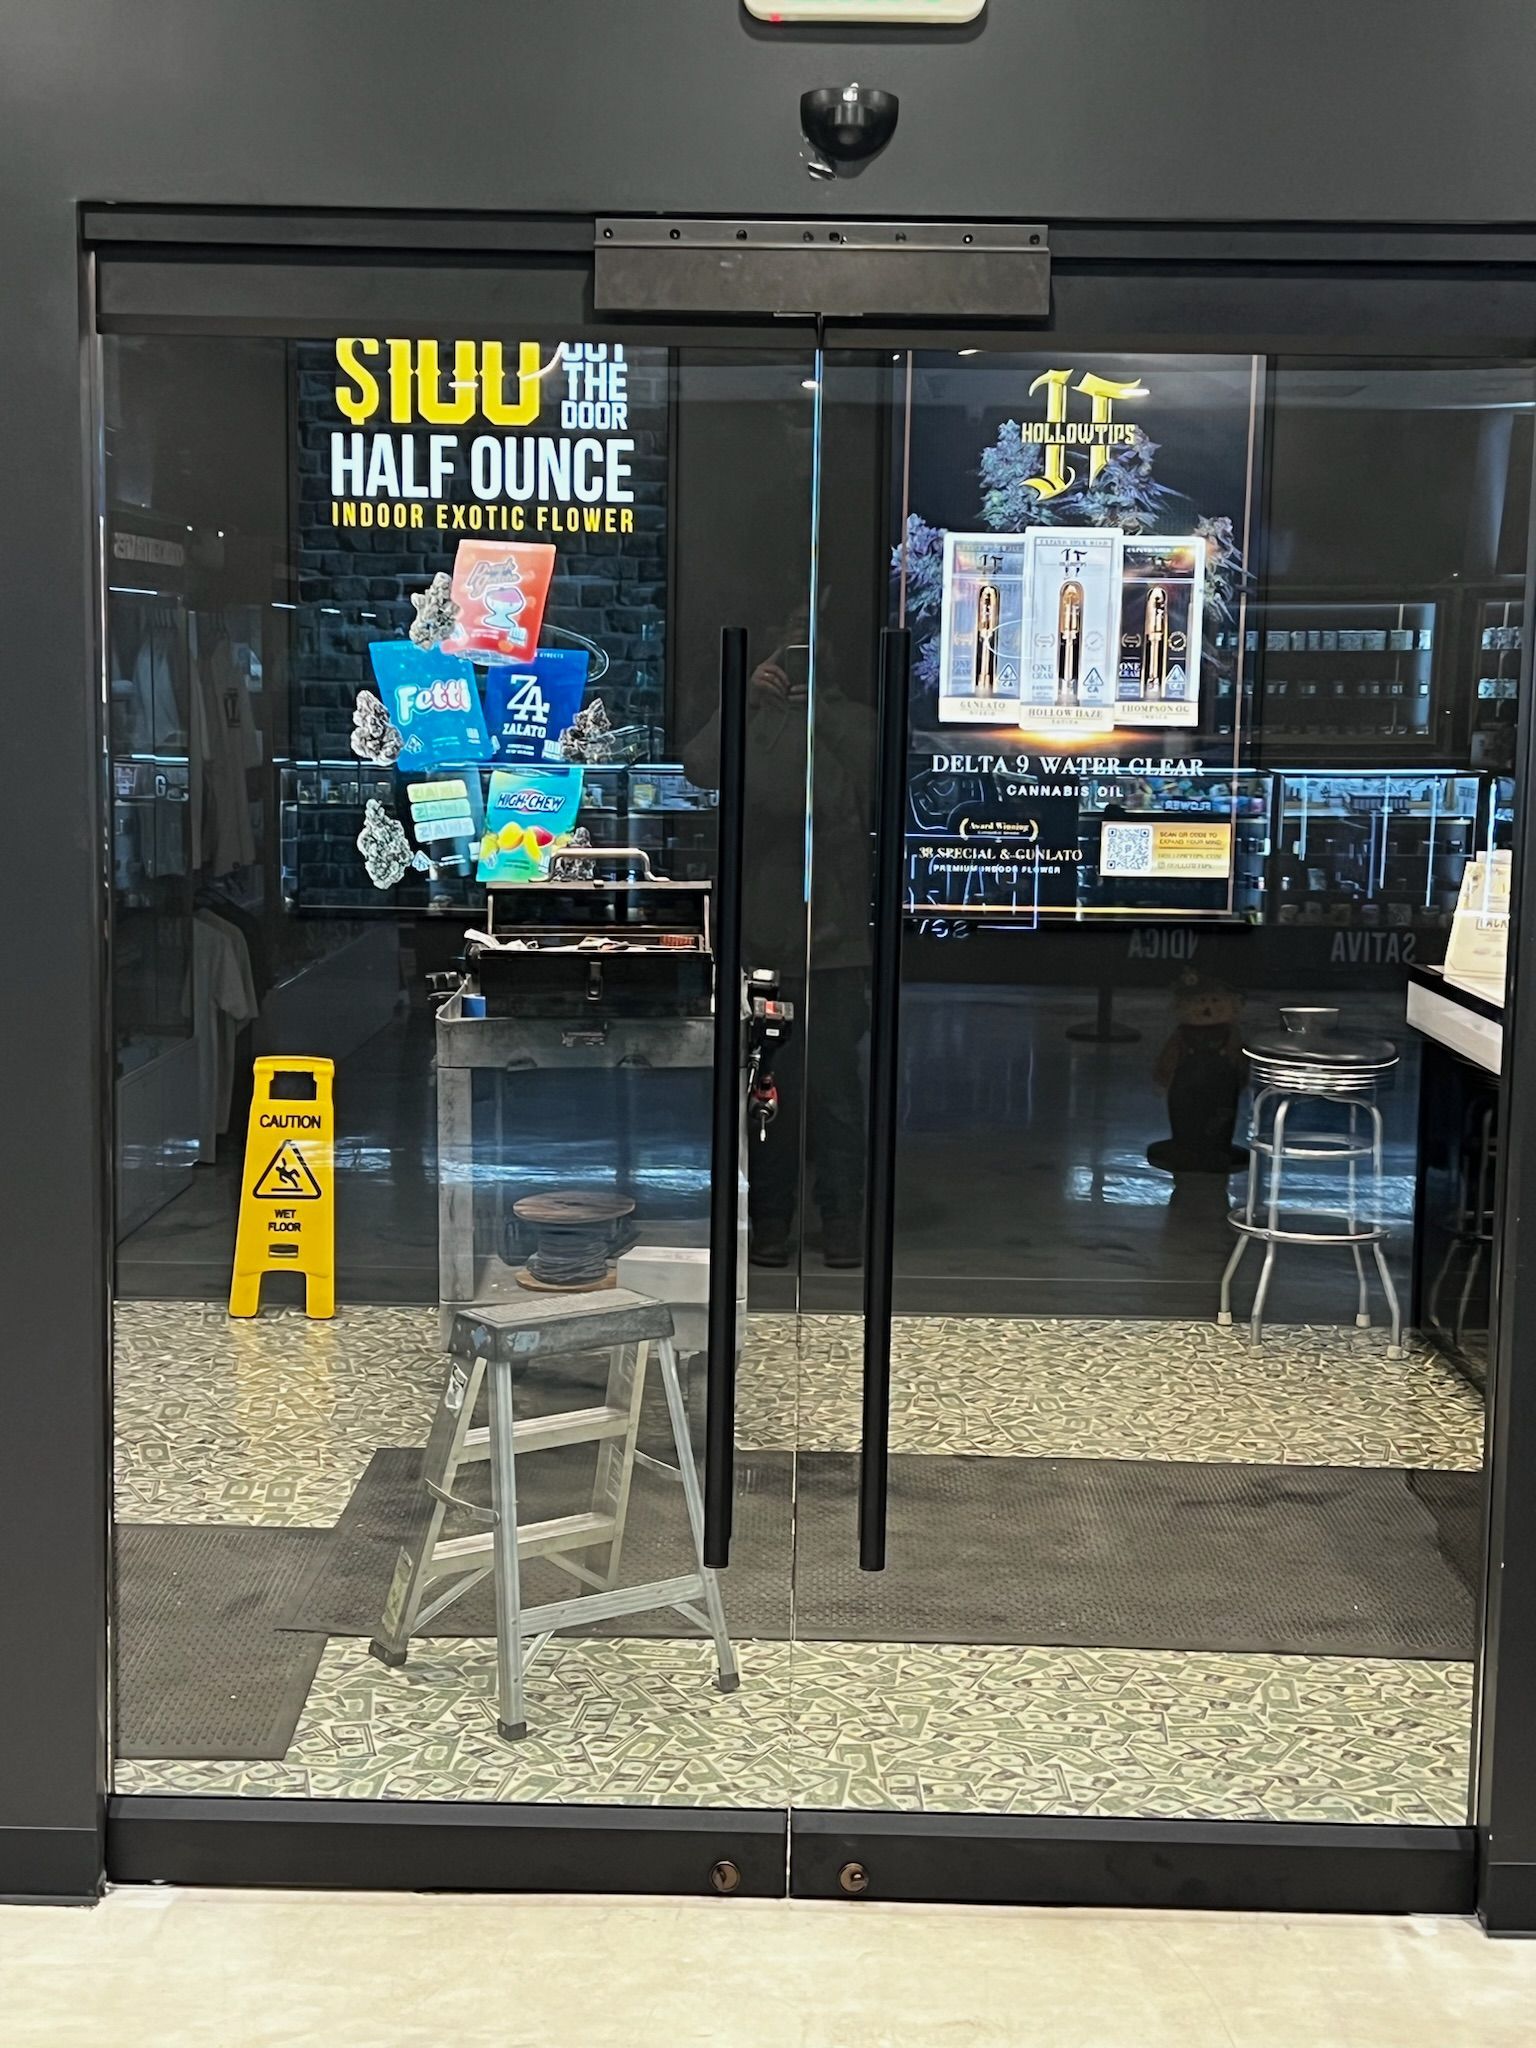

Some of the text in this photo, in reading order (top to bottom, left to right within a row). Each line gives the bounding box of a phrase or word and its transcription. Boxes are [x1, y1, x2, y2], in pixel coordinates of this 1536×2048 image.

[562, 361, 628, 402] THE
[561, 400, 628, 430] DOOR
[1021, 422, 1136, 445] HOLLOWTIPS
[330, 432, 635, 502] HALF OUNCE
[331, 501, 635, 534] INDOOR EXOTIC FLOWER
[1028, 708, 1072, 717] HOLLOW
[502, 723, 547, 739] ZALATO
[931, 755, 1205, 776] DELTA 9 WATER CLEAR
[1006, 784, 1124, 798] CANNABIS OIL
[936, 848, 996, 860] SPECIAL
[1000, 848, 1010, 859] &
[1015, 848, 1083, 861] GUNLATO
[259, 1114, 321, 1129] CAUTION
[274, 1209, 297, 1219] WET
[268, 1222, 301, 1232] FLOOR
